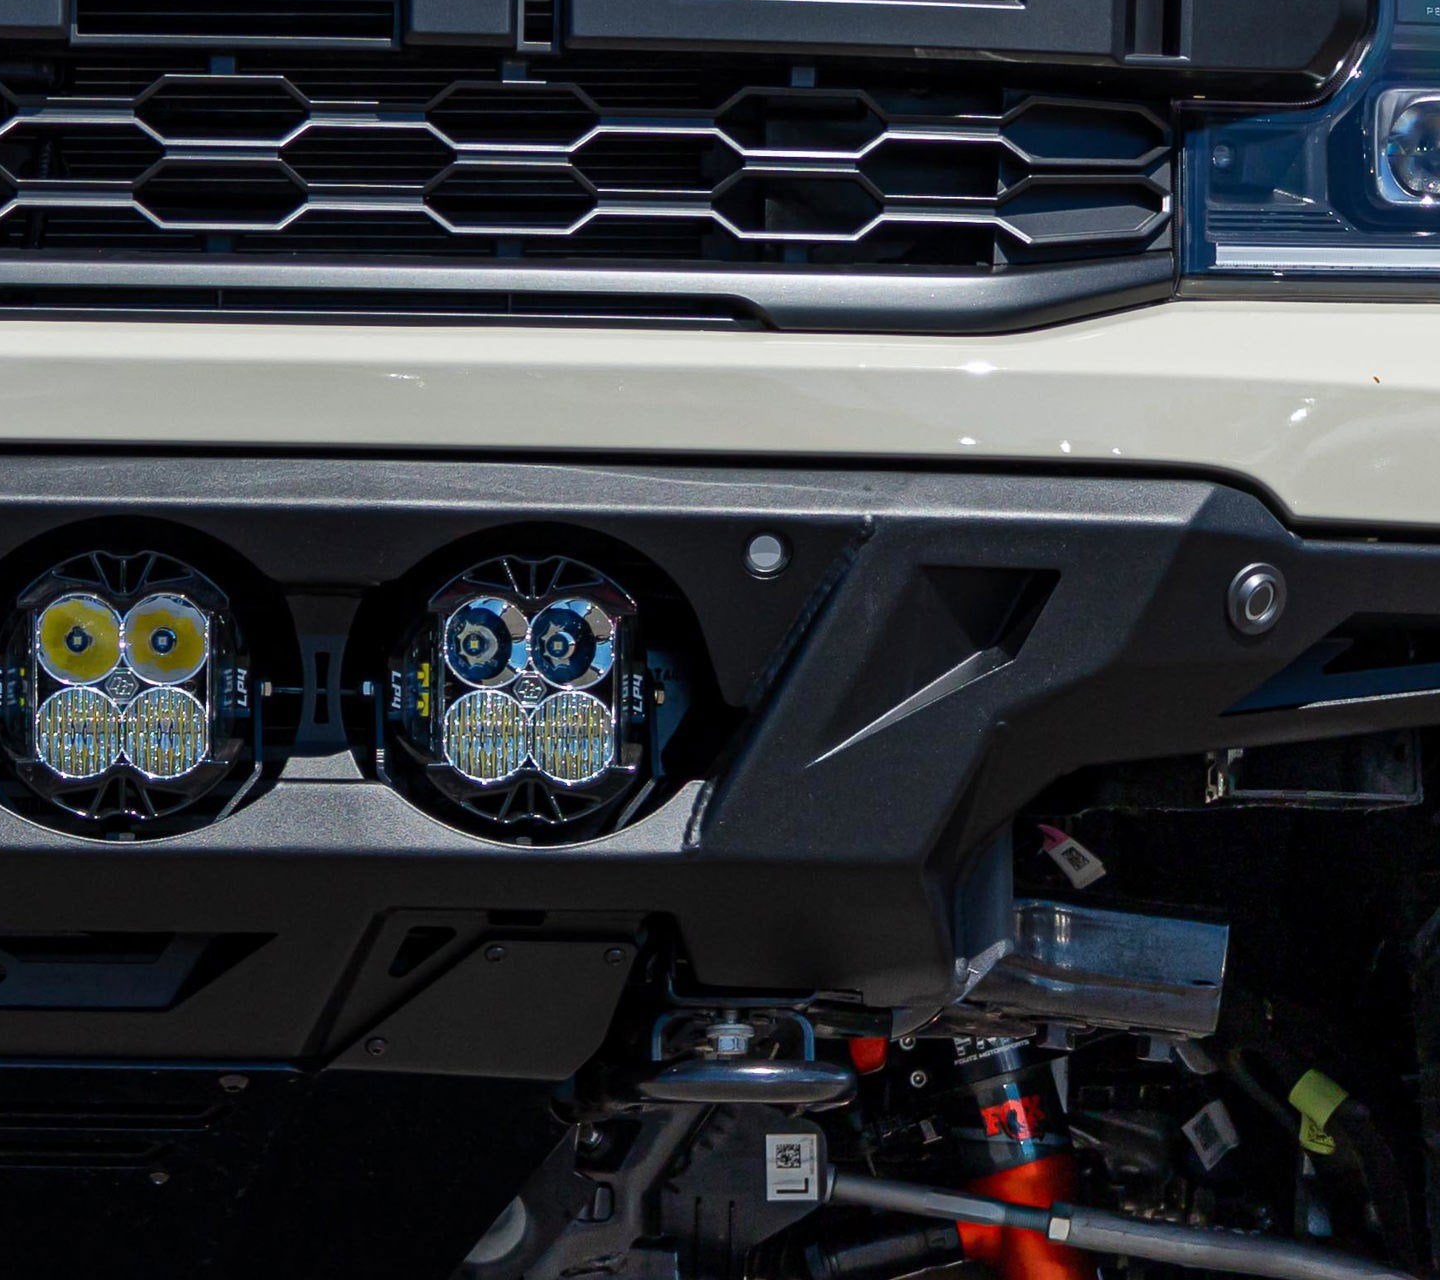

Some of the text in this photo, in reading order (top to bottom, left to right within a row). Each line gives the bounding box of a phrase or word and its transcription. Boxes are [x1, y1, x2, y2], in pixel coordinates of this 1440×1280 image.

[236, 667, 248, 708] LP4
[390, 669, 402, 710] LP4
[631, 673, 643, 714] LP4
[981, 1095, 1045, 1140] FOX
[776, 1177, 809, 1194] L
